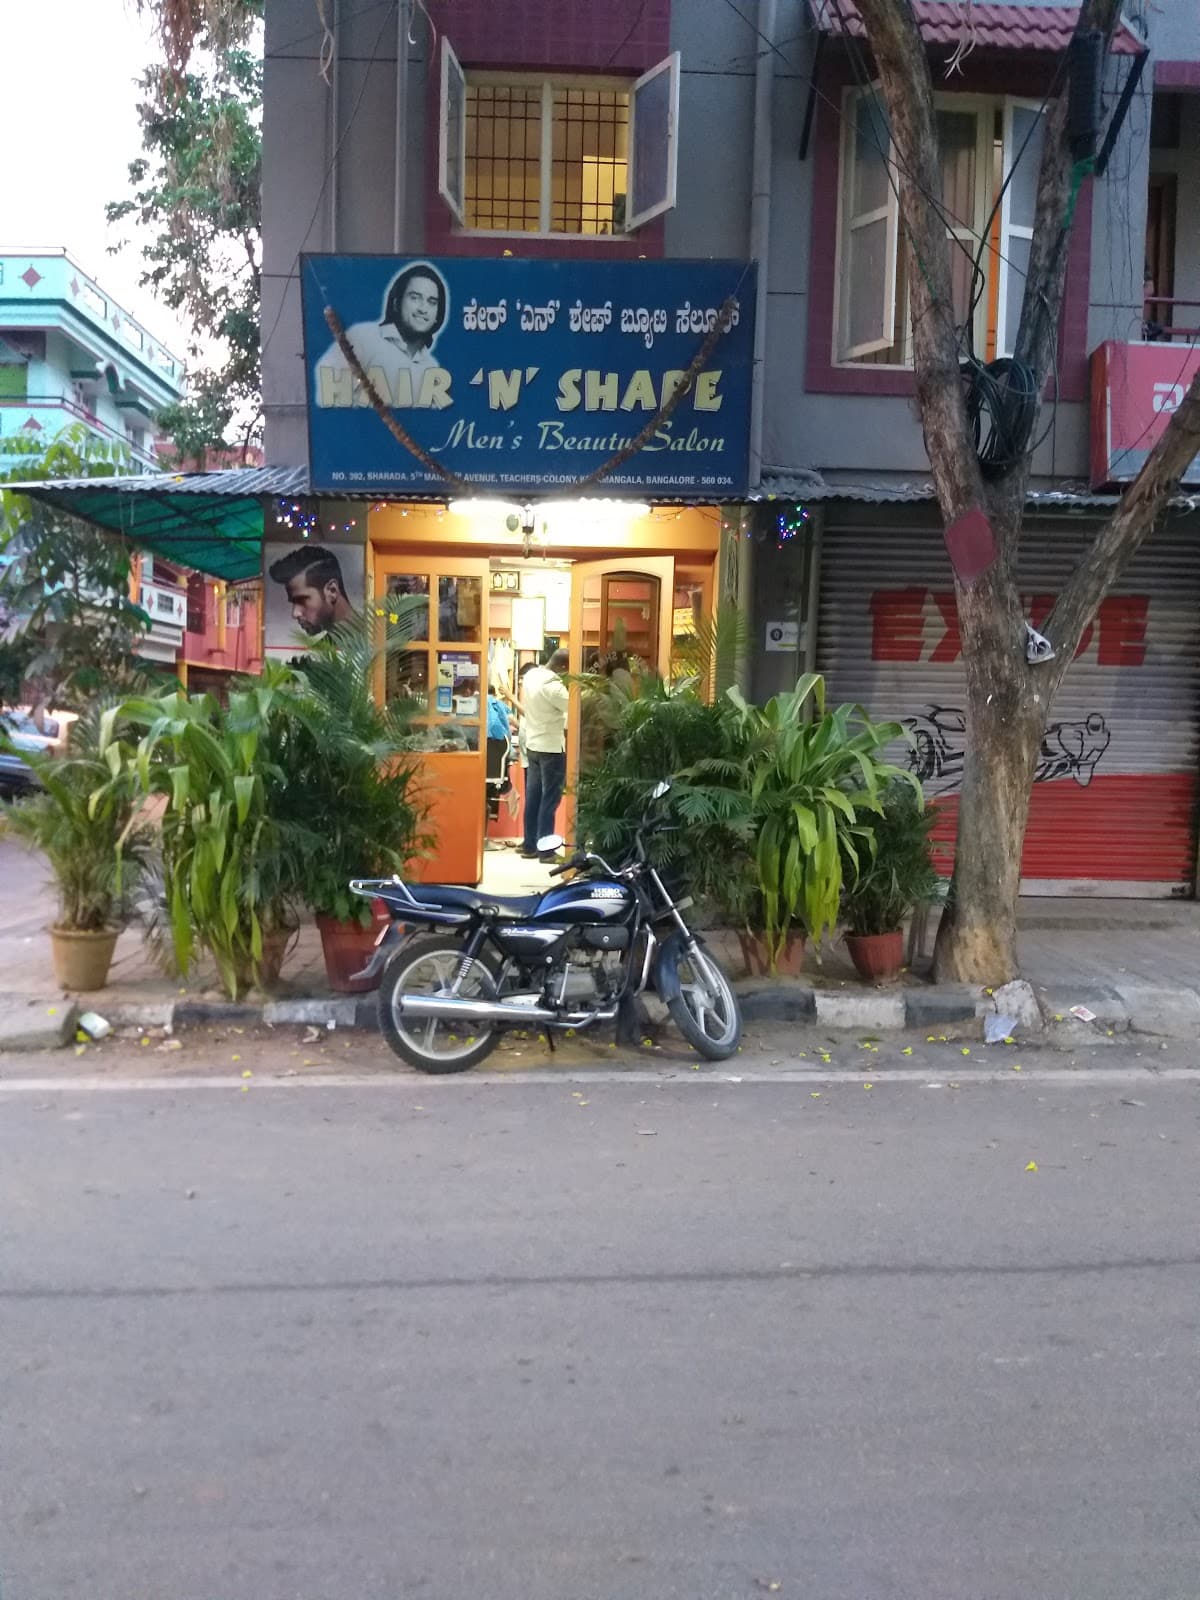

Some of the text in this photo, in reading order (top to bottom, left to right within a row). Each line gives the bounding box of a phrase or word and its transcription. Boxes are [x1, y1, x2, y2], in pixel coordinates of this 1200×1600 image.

[463, 298, 507, 331] ಹೇರ್
[568, 299, 612, 332] ಶೇಪ್
[319, 366, 454, 410] HAIR
[556, 368, 724, 412] SHAPE
[429, 419, 523, 452] Men's
[641, 421, 725, 452] Salon
[646, 475, 696, 485] BANGALORE
